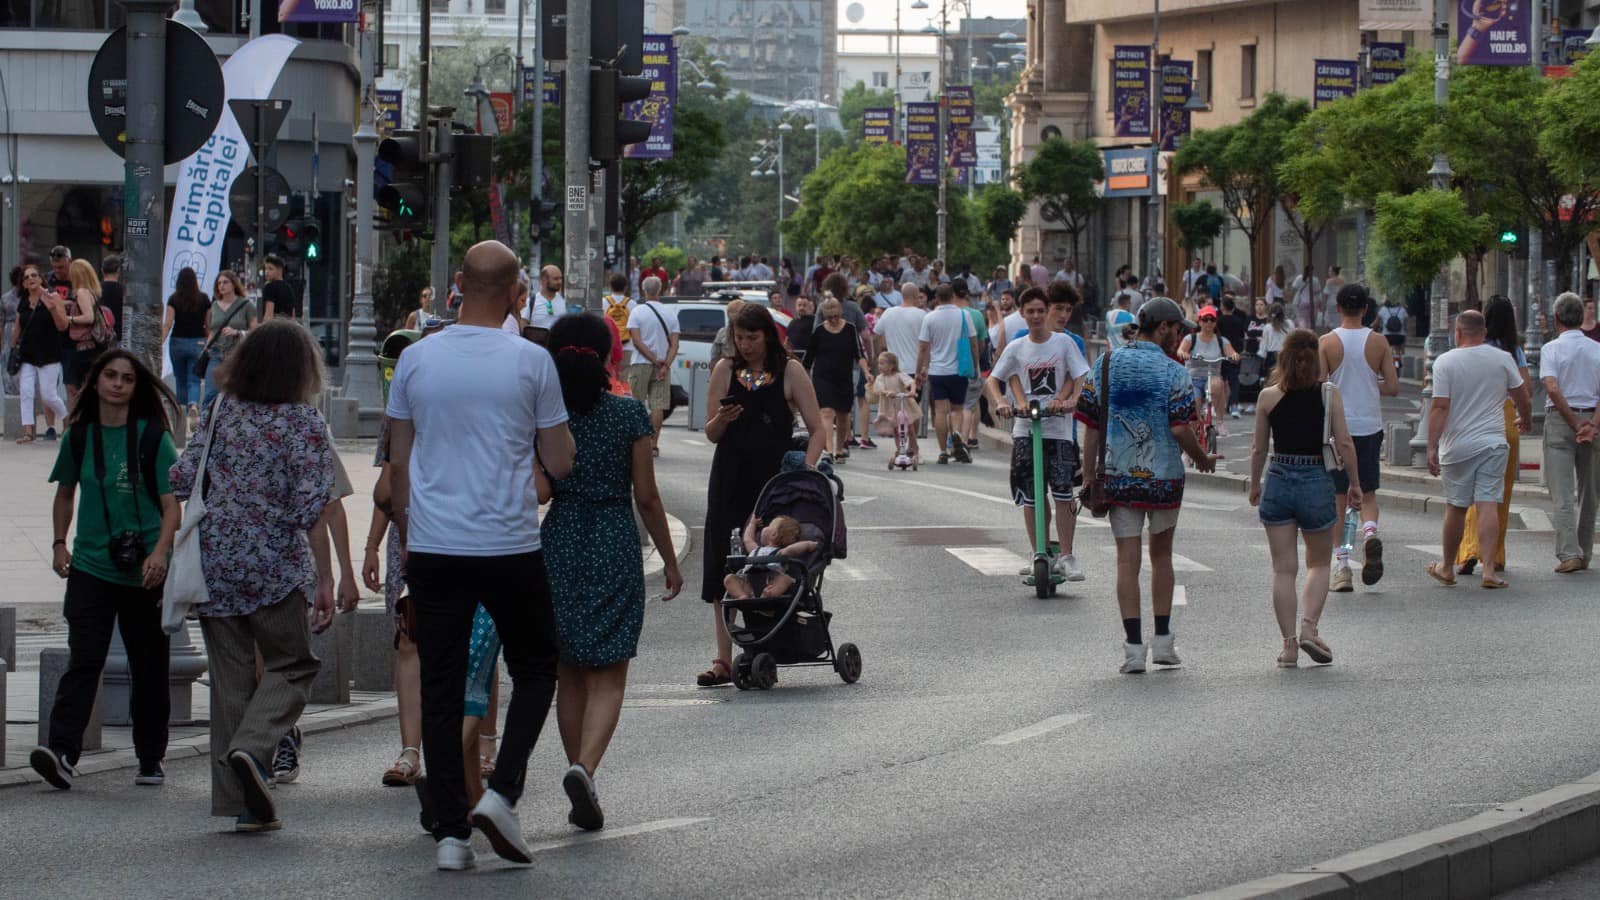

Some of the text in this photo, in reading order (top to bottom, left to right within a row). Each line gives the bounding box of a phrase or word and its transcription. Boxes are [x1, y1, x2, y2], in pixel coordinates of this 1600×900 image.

[314, 0, 353, 10] YOXO.RO
[1490, 31, 1517, 41] HAI PE
[660, 43, 666, 51] O
[1490, 43, 1526, 53] YOXO.RO
[177, 135, 217, 242] Primăria
[197, 135, 239, 246] Capitalei
[569, 187, 585, 198] BNE
